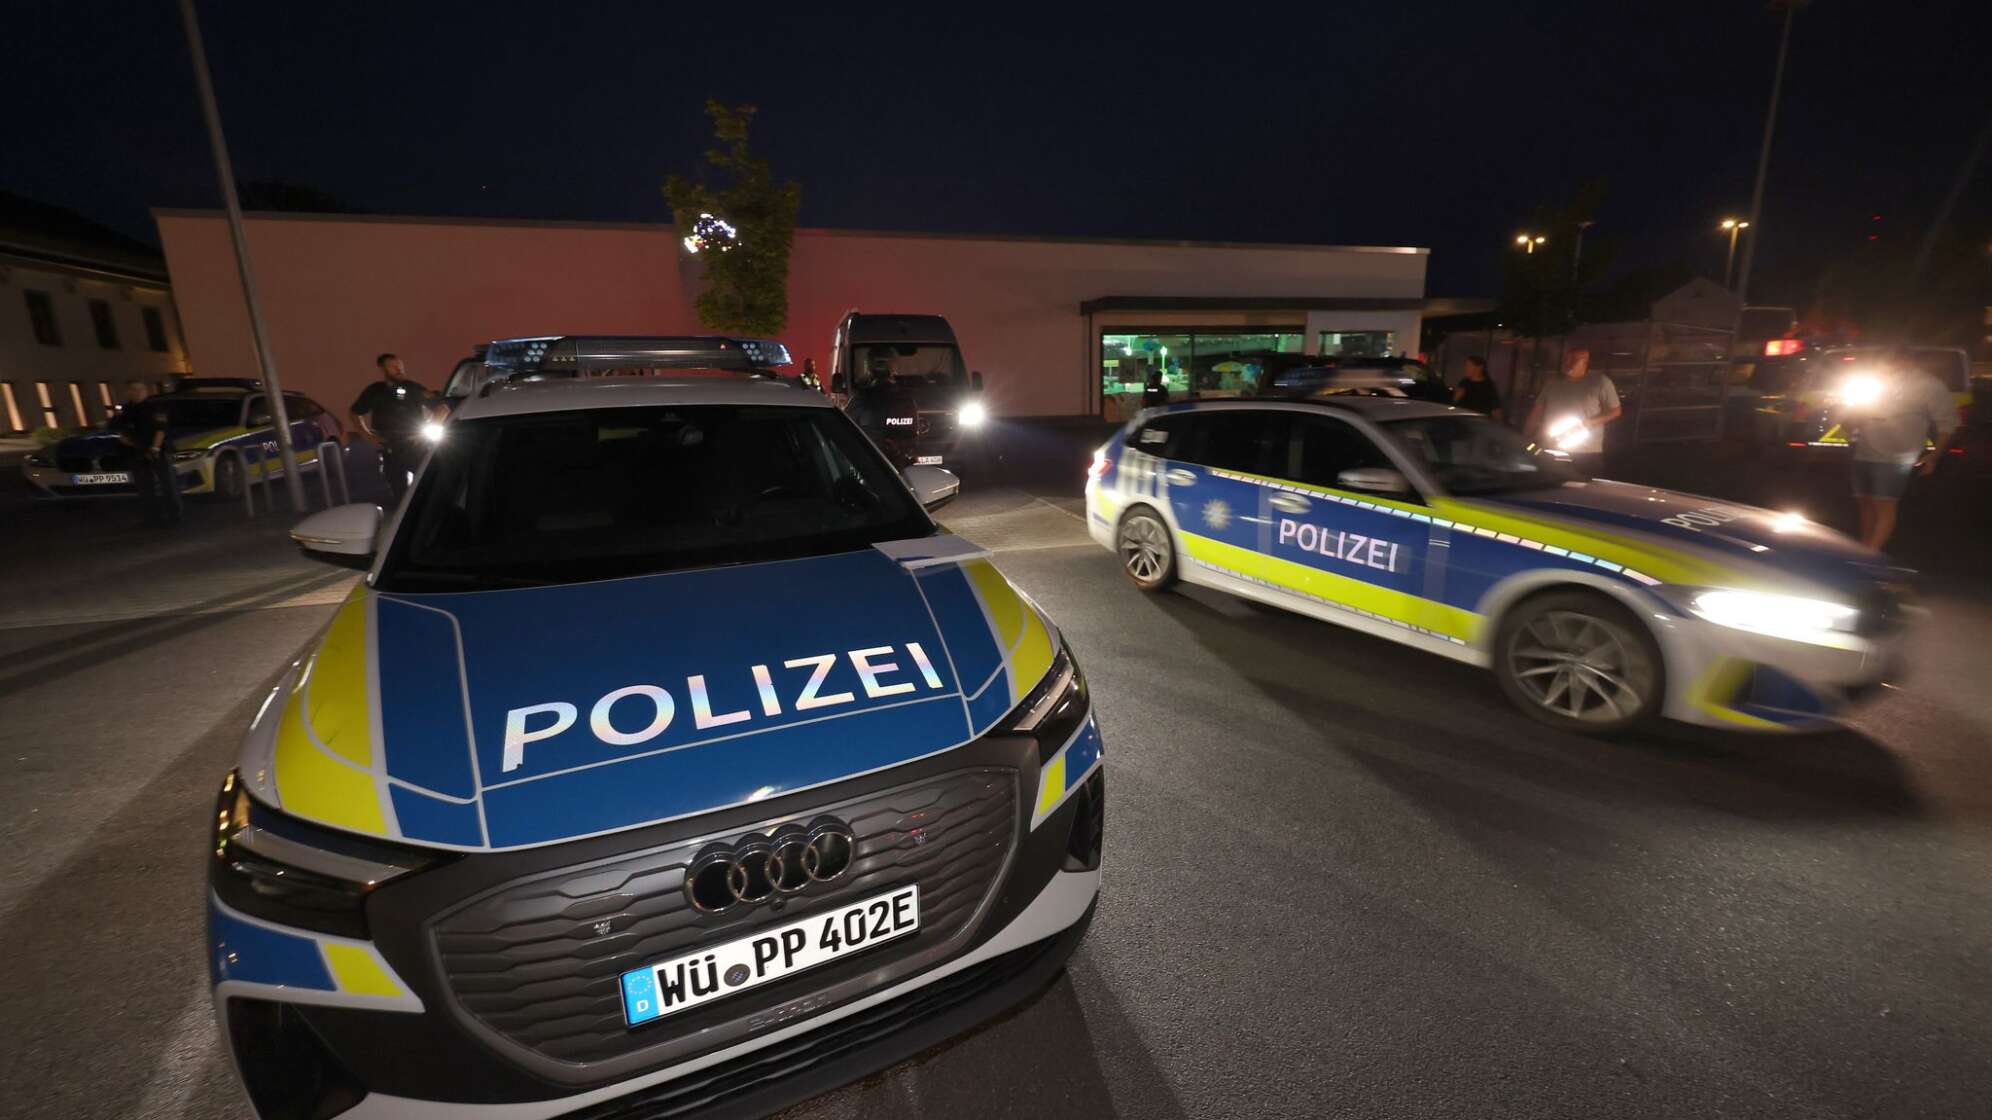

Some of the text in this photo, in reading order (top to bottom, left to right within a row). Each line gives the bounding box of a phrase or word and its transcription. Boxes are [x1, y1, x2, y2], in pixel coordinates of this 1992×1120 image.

[885, 417, 914, 426] POLIZEI
[1278, 517, 1400, 574] POLIZEI
[501, 641, 945, 773] POLIZEI
[656, 890, 917, 1007] WÜ PP 402E
[636, 1000, 650, 1014] D
